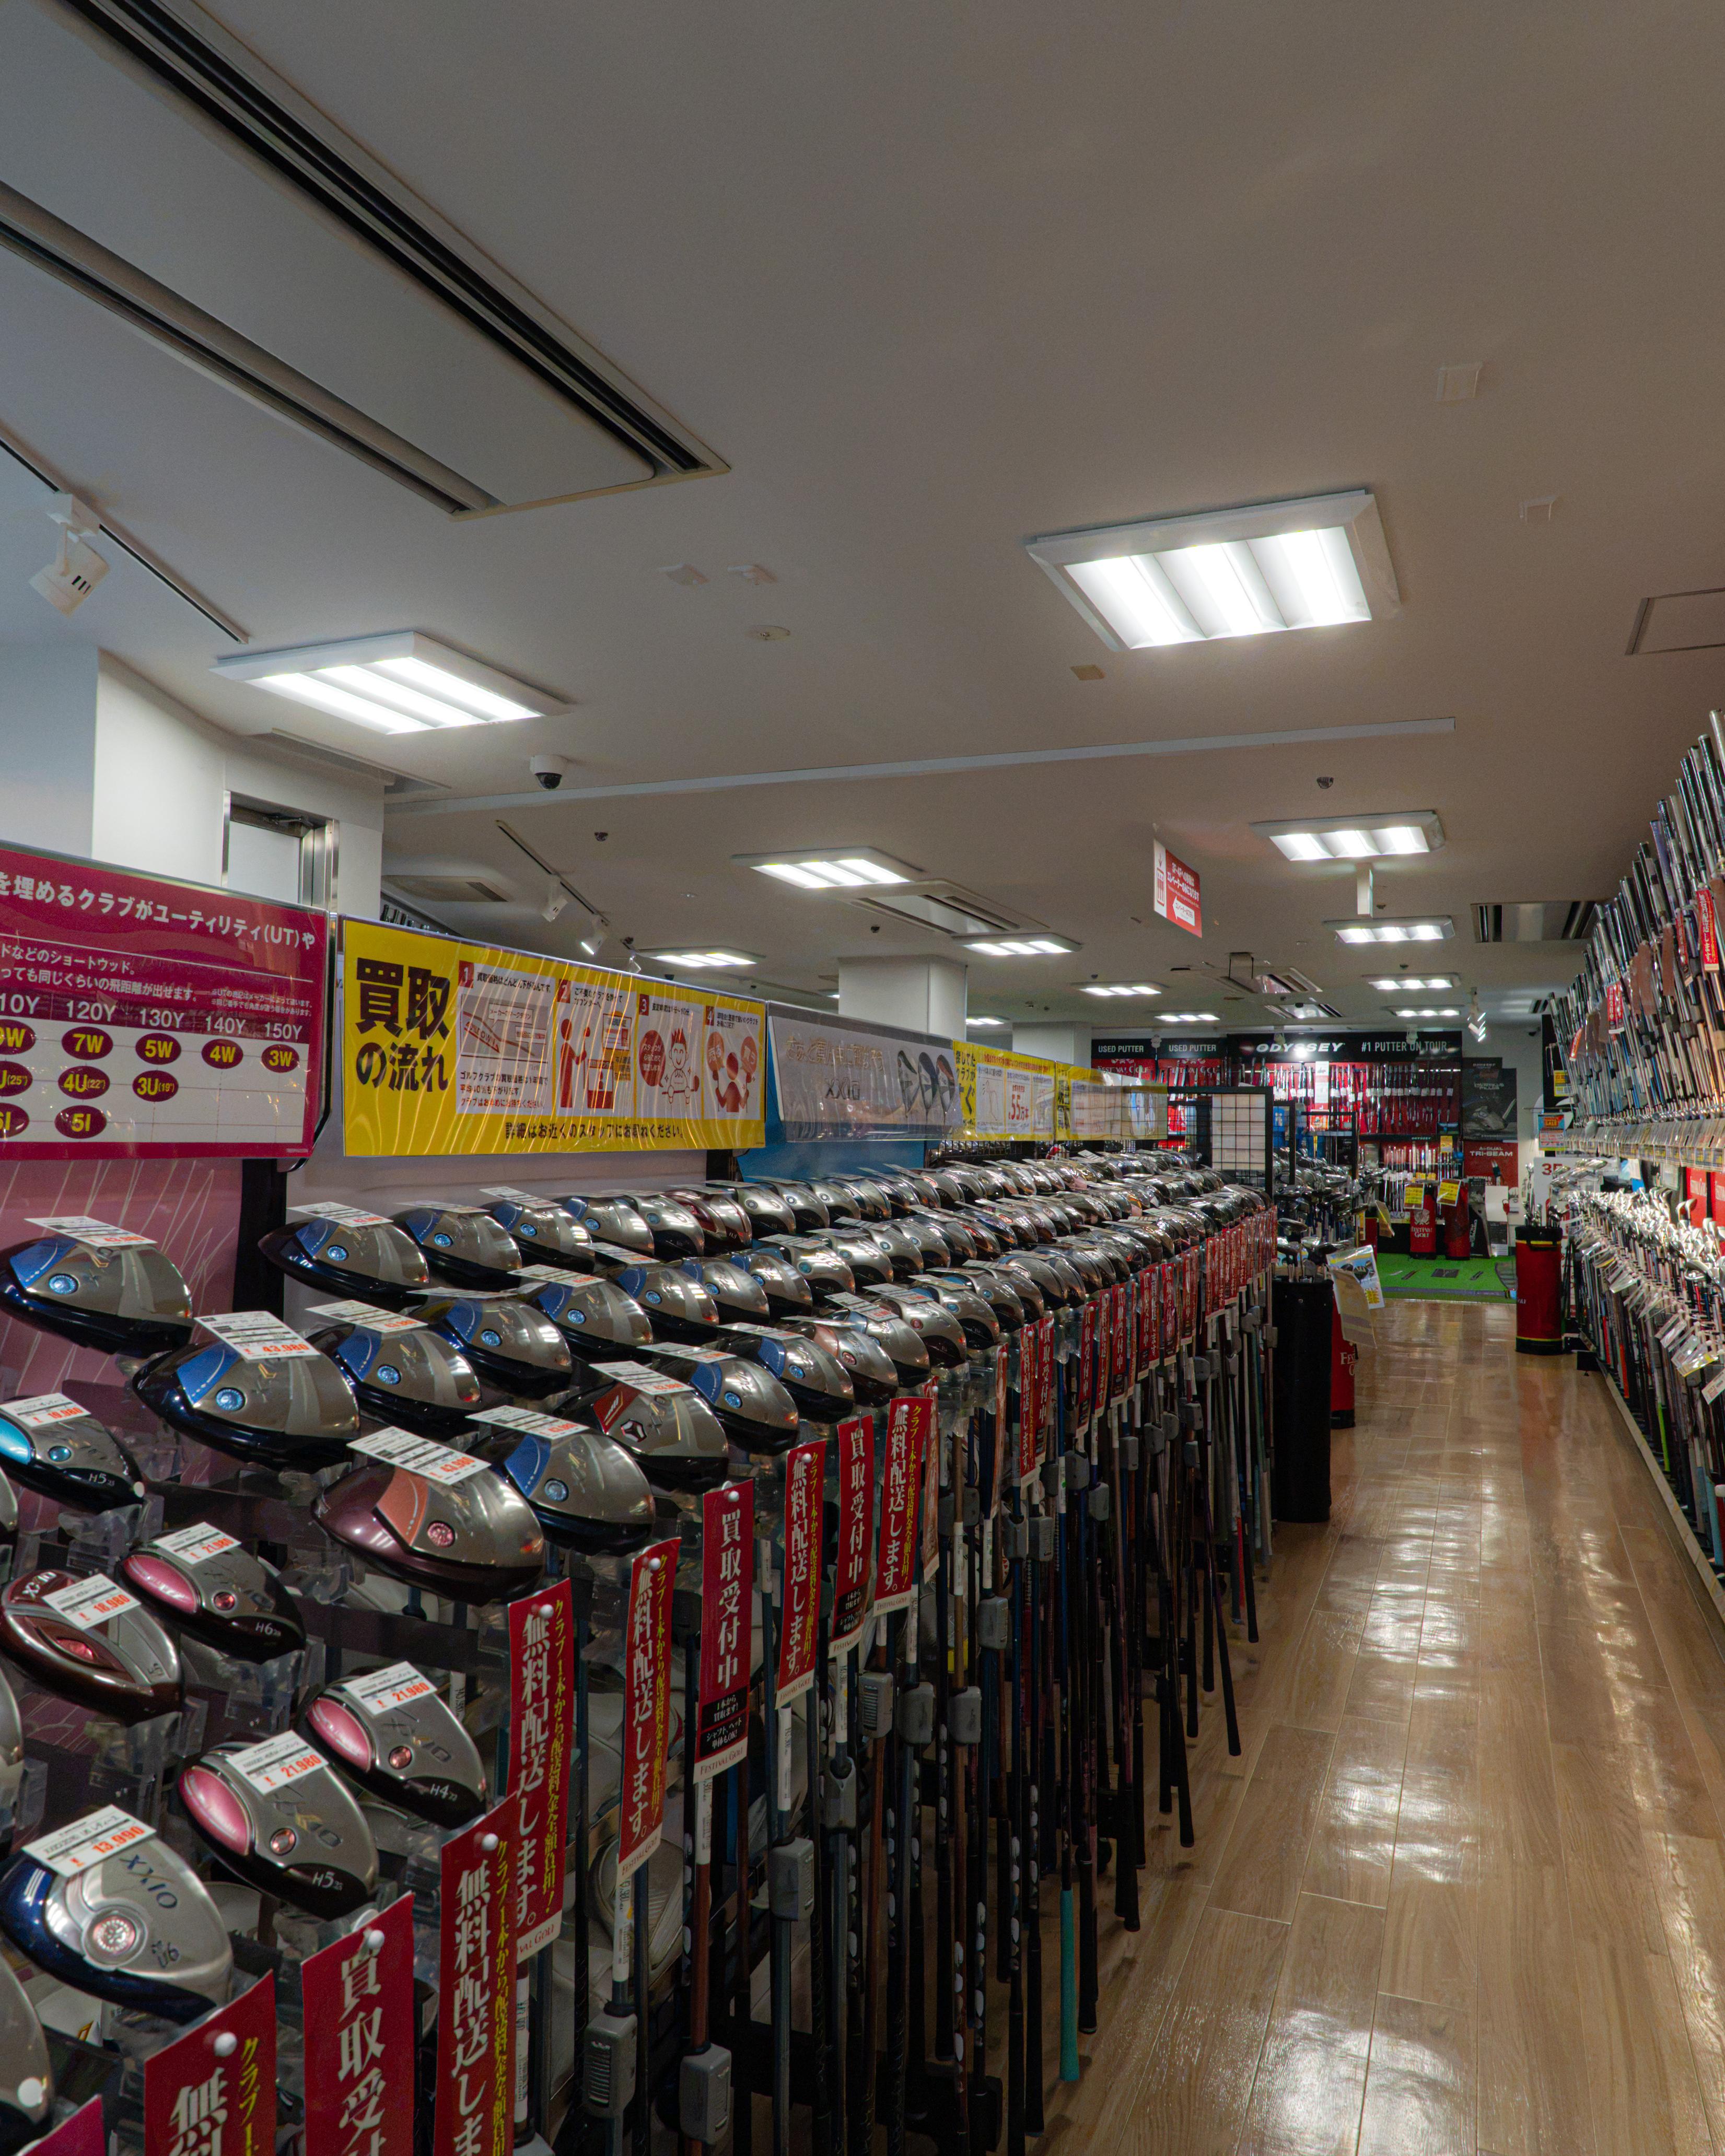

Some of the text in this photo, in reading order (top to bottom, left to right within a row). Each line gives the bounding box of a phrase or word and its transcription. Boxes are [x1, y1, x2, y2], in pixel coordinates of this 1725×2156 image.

[463, 967, 469, 984] 1
[355, 957, 450, 1041] 買取
[561, 984, 567, 1000] 2
[642, 998, 647, 1012] 3
[707, 1010, 713, 1023] 4
[67, 1000, 116, 1022] 120Y
[140, 1009, 184, 1028] 130Y
[205, 1015, 246, 1034] 140Y
[265, 1022, 302, 1042] 150Y
[73, 1033, 104, 1053] 7W
[145, 1039, 173, 1058] 5W
[209, 1046, 235, 1062] 4W
[269, 1050, 293, 1067] 3W
[1169, 1044, 1217, 1052] USED PUTTER
[1256, 1040, 1448, 1053] ODYSSEY #1 PUTTER ON TOUR
[356, 1042, 449, 1092] の流れ
[71, 1113, 91, 1132] 5I
[89, 1472, 108, 1484] H5
[848, 1428, 866, 1584] 買取受付中
[883, 1408, 908, 1591] 無料配送します。
[202, 1537, 235, 1555] 21,980
[786, 1459, 808, 1677] 無料配送します。
[93, 1593, 131, 1613] 18,980
[717, 1509, 741, 1690] 買取受付中
[255, 1622, 273, 1635] H6
[392, 1681, 430, 1703] 21,980
[628, 1568, 654, 1844] 無料配送します。
[280, 1754, 322, 1778] 21,980
[516, 1613, 551, 1929] 無料配送します。
[700, 1747, 743, 1776] FESTIVAL GOLF
[430, 1784, 450, 1800] H4
[92, 1825, 146, 1854] 13,990
[312, 1871, 335, 1889] H5
[168, 2067, 228, 2156] 無
